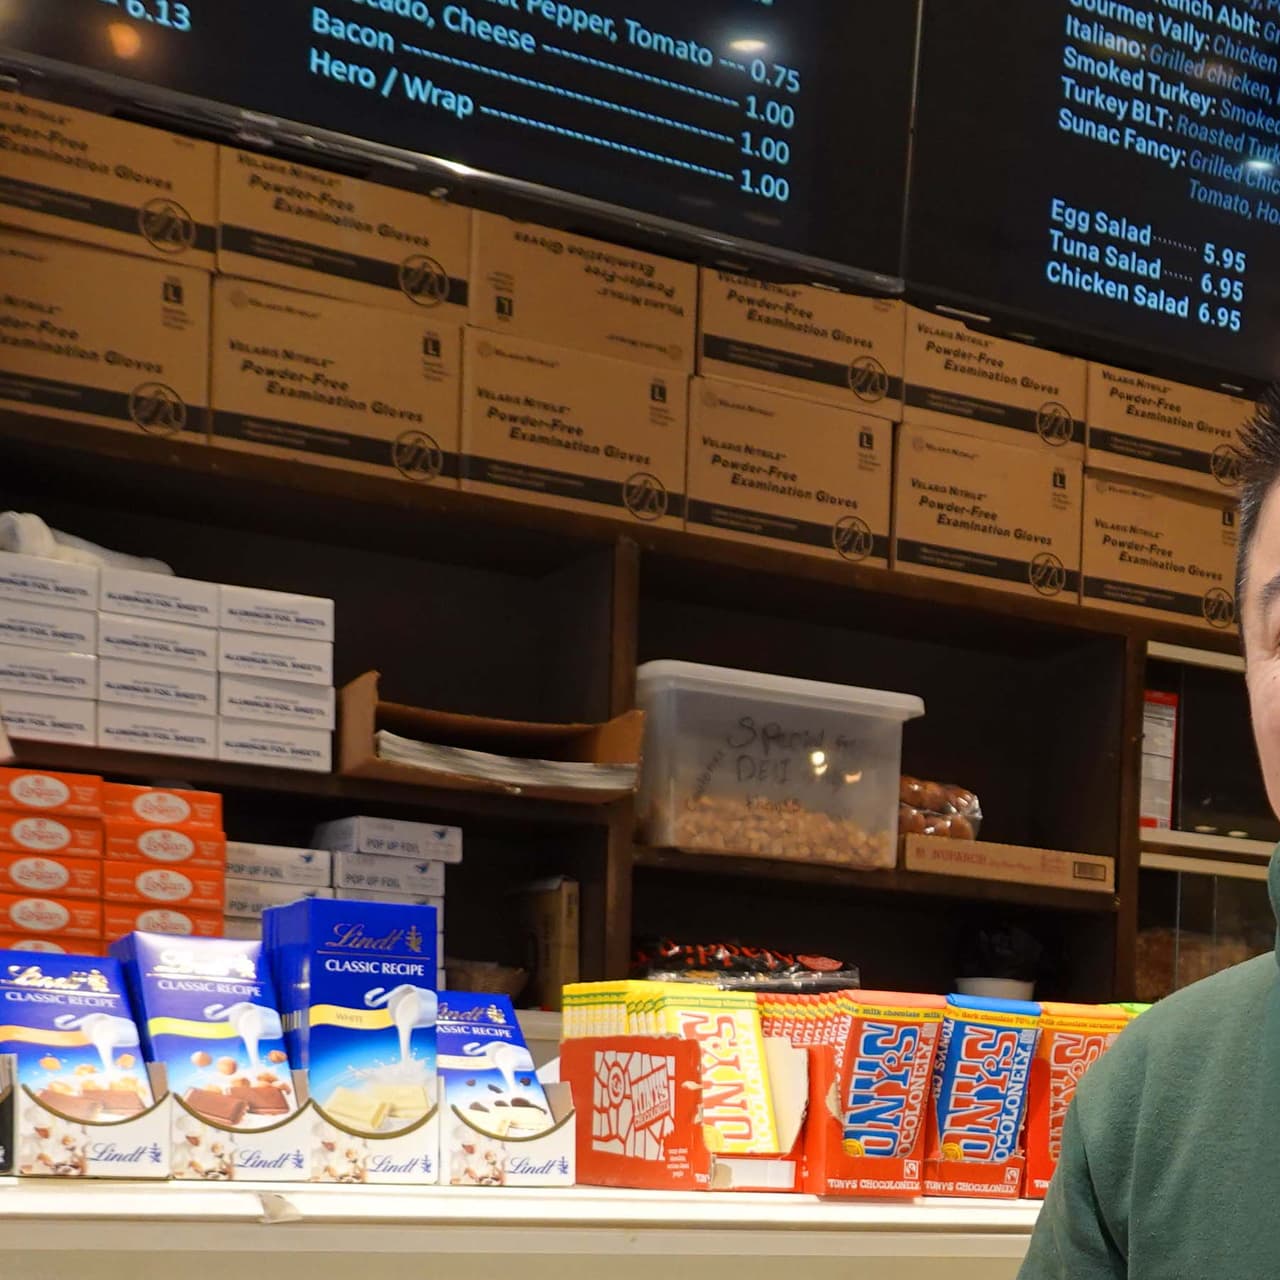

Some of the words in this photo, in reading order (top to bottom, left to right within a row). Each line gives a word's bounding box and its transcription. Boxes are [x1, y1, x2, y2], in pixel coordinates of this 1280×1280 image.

[625, 18, 712, 67] Tomato
[751, 58, 800, 95] 0.75
[1065, 13, 1147, 62] Italiano:
[1158, 12, 1210, 52] Vally:
[1212, 34, 1277, 73] Chicken
[310, 7, 395, 54] Bacon
[740, 131, 789, 166] 1.00
[442, 5, 536, 54] Cheese
[745, 95, 794, 130] 1.00
[1063, 45, 1144, 92] Smoked
[1148, 71, 1216, 118] Turkey:
[308, 47, 376, 91] Hero
[402, 73, 474, 119] Wrap
[740, 168, 789, 202] 1.00
[1060, 75, 1129, 121] Turkey
[1132, 98, 1174, 133] BLT:
[1058, 107, 1121, 146] Sunac
[1123, 126, 1187, 170] Fancy:
[1049, 228, 1100, 263] Tuna
[1105, 245, 1162, 280] Salad
[1201, 272, 1245, 303] 6.95
[1051, 199, 1091, 233] Egg
[1094, 211, 1152, 247] Salad
[1203, 242, 1247, 274] 5.95
[1046, 260, 1129, 303] Chicken
[1133, 284, 1190, 318] Salad
[1198, 302, 1242, 332] 6.95
[324, 922, 404, 951] Lindt
[157, 979, 215, 994] CLASSIC
[216, 981, 262, 998] RECIPE
[325, 958, 380, 975] CLASSIC
[382, 961, 425, 977] RECIPE
[5, 990, 66, 1005] CLASSIC
[68, 993, 117, 1009] RECIPE
[87, 1142, 146, 1164] Lindt
[235, 1149, 290, 1170] Lindt
[367, 1153, 419, 1174] Lindt
[504, 1155, 557, 1176] Lindt
